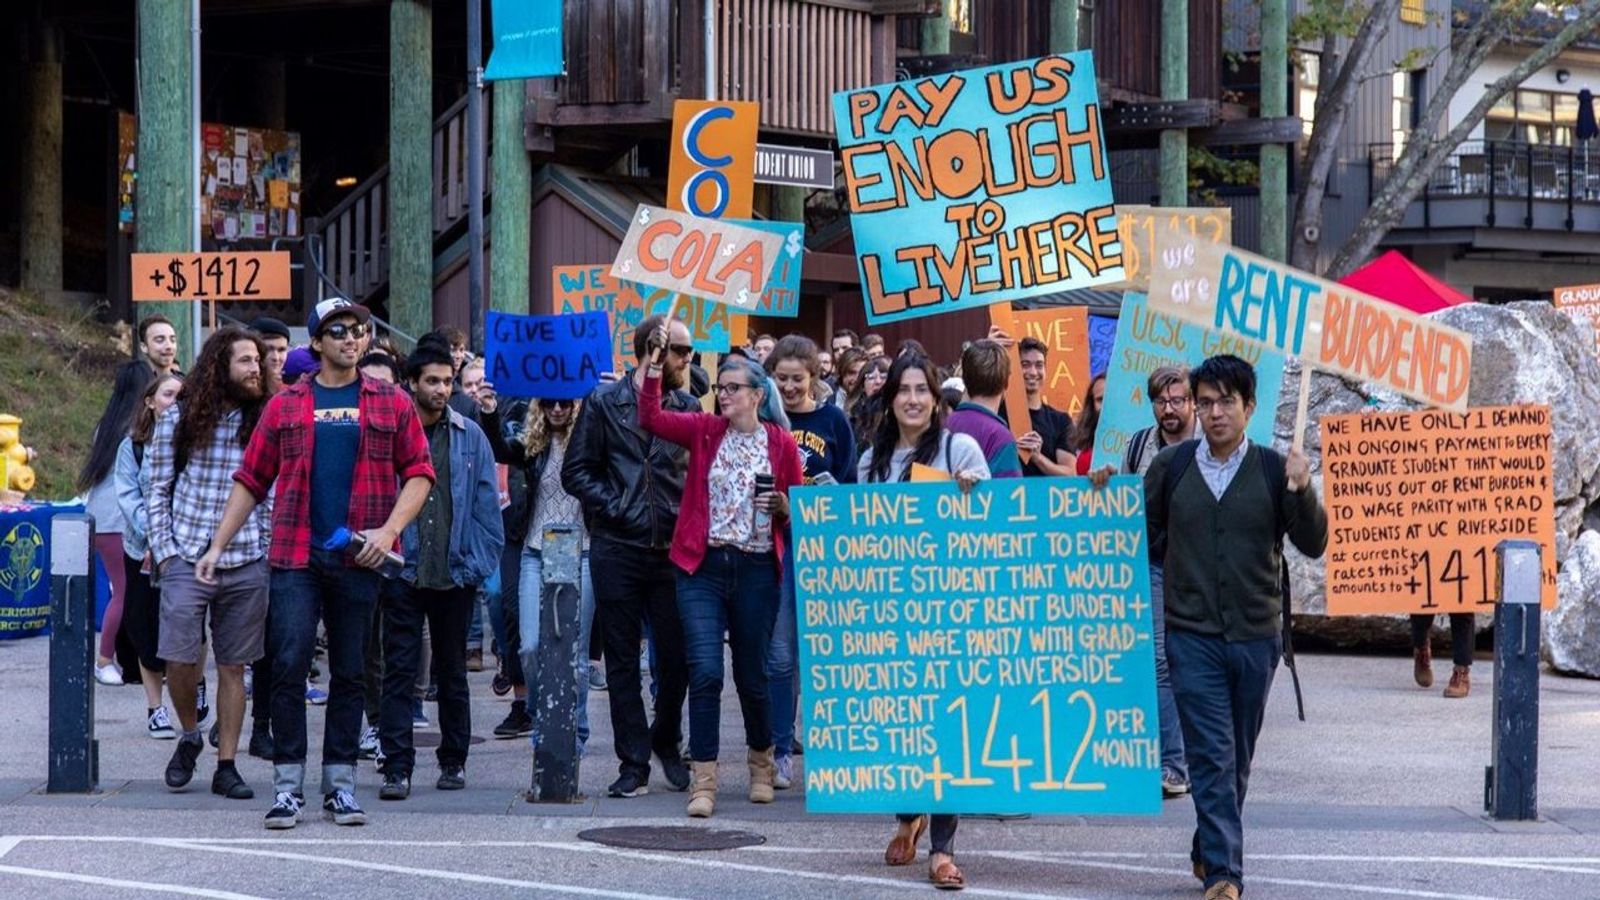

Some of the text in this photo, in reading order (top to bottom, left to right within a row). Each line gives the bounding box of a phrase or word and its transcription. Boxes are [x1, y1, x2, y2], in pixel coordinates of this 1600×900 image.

[849, 56, 1075, 139] PAY US
[754, 151, 815, 180] TUDENT UNION
[841, 104, 1105, 213] ENOUGH
[945, 199, 1005, 241] TO
[637, 219, 763, 296] COLA
[149, 256, 261, 298] +$1412
[560, 269, 605, 293] WE
[1171, 277, 1210, 304] are
[1215, 253, 1321, 356] RENT
[494, 315, 598, 342] GIVE US
[1320, 291, 1471, 404] BURDENED
[493, 352, 511, 379] A
[1050, 360, 1076, 389] A
[1327, 419, 1351, 435] WE
[1361, 415, 1411, 433] HAVE
[1421, 412, 1471, 430] ONLY
[1475, 411, 1487, 429] 1
[1327, 440, 1351, 457] AN
[1357, 439, 1428, 456] ONGOING
[1435, 436, 1501, 454] PAYMENT
[1515, 434, 1550, 452] EVERY
[1329, 455, 1545, 479] GRADUATE STUDENT THAT WOULD
[1332, 482, 1373, 498] BRING
[1376, 481, 1392, 497] US
[1398, 480, 1427, 496] OUT
[1432, 479, 1449, 493] OF
[1453, 476, 1485, 493] RENT
[1488, 475, 1535, 492] BURDEN
[799, 496, 838, 525] WE
[850, 492, 923, 526] HAVE
[936, 490, 993, 521] ONLY
[1008, 485, 1037, 521] 1
[1332, 495, 1542, 521] TO WAGE PARITY WITH GRAD
[1334, 517, 1538, 544] STUDENTS AT UC RIVERSIDE
[797, 530, 1141, 563] AN ONGOING PAYMENT TO EVERY
[1332, 546, 1408, 562] at current
[800, 562, 1133, 594] GRADUATE STUDENT THAT WOULD
[1333, 561, 1408, 581] rates this
[1332, 580, 1402, 594] amounts to
[806, 599, 869, 627] BRING
[874, 599, 898, 624] US
[904, 599, 945, 625] OUT
[949, 598, 981, 625] OF
[984, 596, 1040, 625] RENT
[1047, 593, 1125, 622] BURDEN
[803, 632, 833, 656] TO
[843, 629, 899, 657] BRING
[906, 628, 962, 657] WAGE
[966, 626, 1022, 658] PARITY
[1029, 625, 1073, 653] WITH
[811, 653, 1123, 692] STUDENTS AT UC RIVERSIDE
[814, 693, 940, 727] AT CURRENT
[1105, 706, 1147, 736] PER
[808, 724, 937, 758] RATES THIS
[1092, 737, 1160, 770] MONTH
[807, 764, 896, 795] AMOUNTS
[896, 764, 923, 792] TO
